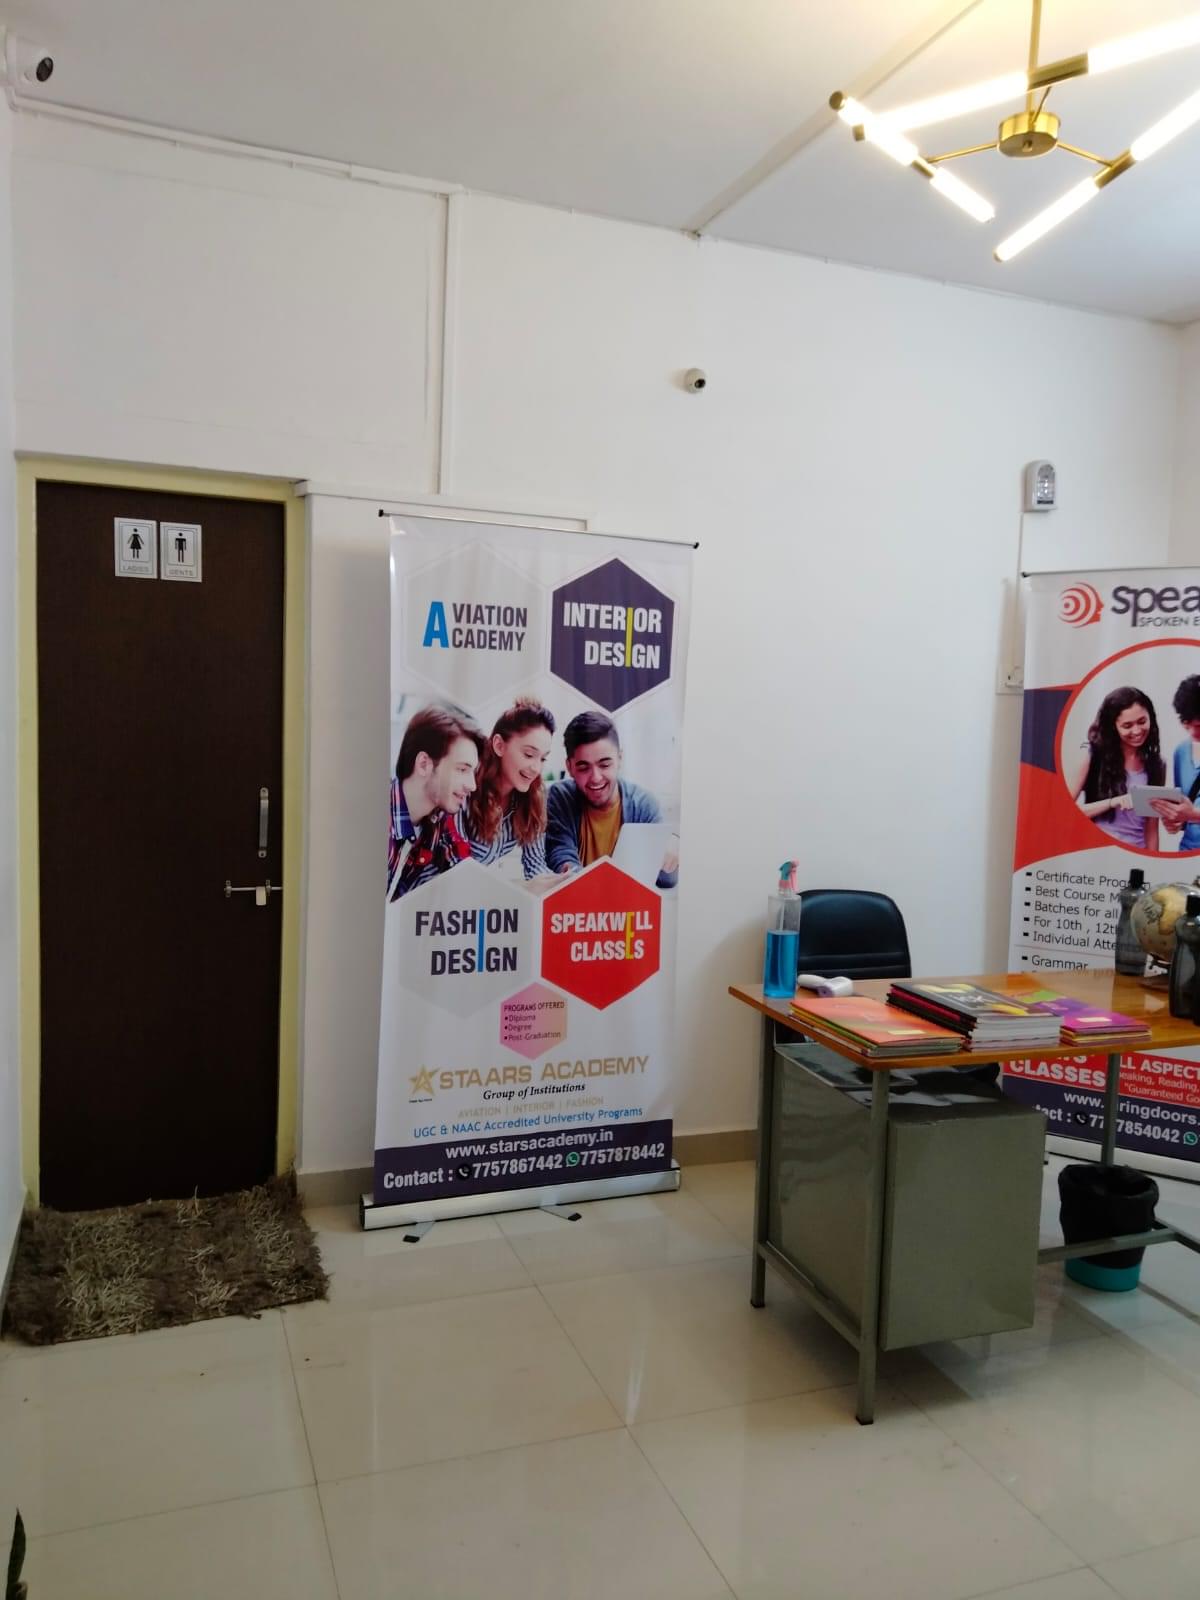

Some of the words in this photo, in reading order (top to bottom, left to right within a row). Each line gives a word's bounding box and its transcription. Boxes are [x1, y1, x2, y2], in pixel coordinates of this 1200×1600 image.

[563, 602, 662, 634] INTERIOR
[1139, 617, 1189, 627] SPOKEN
[584, 641, 660, 669] DESIGN
[1036, 870, 1095, 886] Certificate
[1035, 886, 1060, 898] Best
[1063, 889, 1105, 901] Course
[1034, 901, 1080, 915] Batches
[1084, 907, 1100, 917] for
[1104, 908, 1119, 919] all
[415, 909, 518, 936] FASHION
[550, 910, 653, 934] SPEAKWELL
[1034, 916, 1050, 927] For
[1056, 918, 1082, 931] 10th
[1033, 931, 1090, 947] Individual
[570, 939, 645, 962] CLASSES
[431, 947, 517, 976] DESIGN
[1031, 955, 1089, 970] Grammar
[504, 1003, 537, 1012] PROGRAMS
[538, 1001, 565, 1010] OFFERED
[508, 1015, 536, 1023] Diploma
[508, 1024, 532, 1032] Degree
[1119, 1055, 1136, 1070] LL
[439, 1066, 532, 1090] STAARS
[540, 1056, 649, 1080] ACADEMY
[1009, 1059, 1106, 1087] CLASSES
[1119, 1072, 1155, 1086] eaking,
[483, 1088, 515, 1101] Group
[517, 1087, 531, 1100] of
[530, 1083, 586, 1096] Institutions
[457, 1105, 501, 1119] AVIATION
[513, 1101, 555, 1114] INTERIOR
[566, 1097, 604, 1110] FASHION
[413, 1127, 437, 1138] UGC
[440, 1125, 448, 1135] &
[452, 1122, 481, 1134] NAAC
[483, 1116, 541, 1131] Accredited
[543, 1110, 595, 1125] University
[598, 1107, 643, 1121] Programs
[1089, 1113, 1180, 1143] 777854042
[446, 1129, 613, 1159] www.starsacademy.in
[383, 1170, 443, 1189] Contact
[472, 1153, 562, 1179] 7757867442
[579, 1143, 665, 1166] 7757878442
